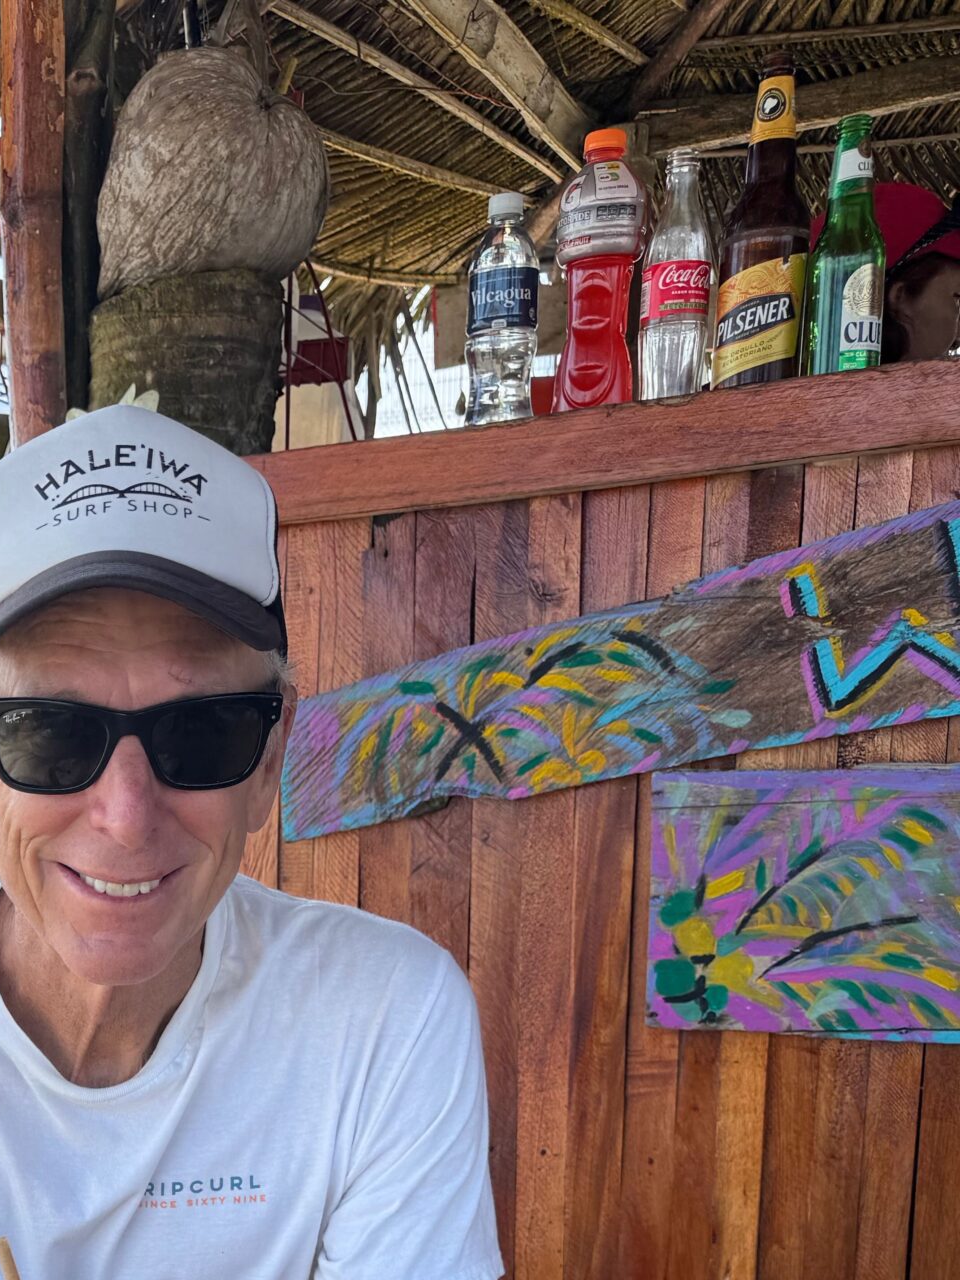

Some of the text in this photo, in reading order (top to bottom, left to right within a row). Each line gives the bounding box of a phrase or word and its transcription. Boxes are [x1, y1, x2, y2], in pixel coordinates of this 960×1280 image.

[471, 286, 531, 308] Vilcagua
[716, 297, 789, 347] PILSENER
[53, 500, 193, 527] SURF SHOP
[186, 1196, 226, 1207] SIXTY
[233, 1194, 267, 1204] NINE
